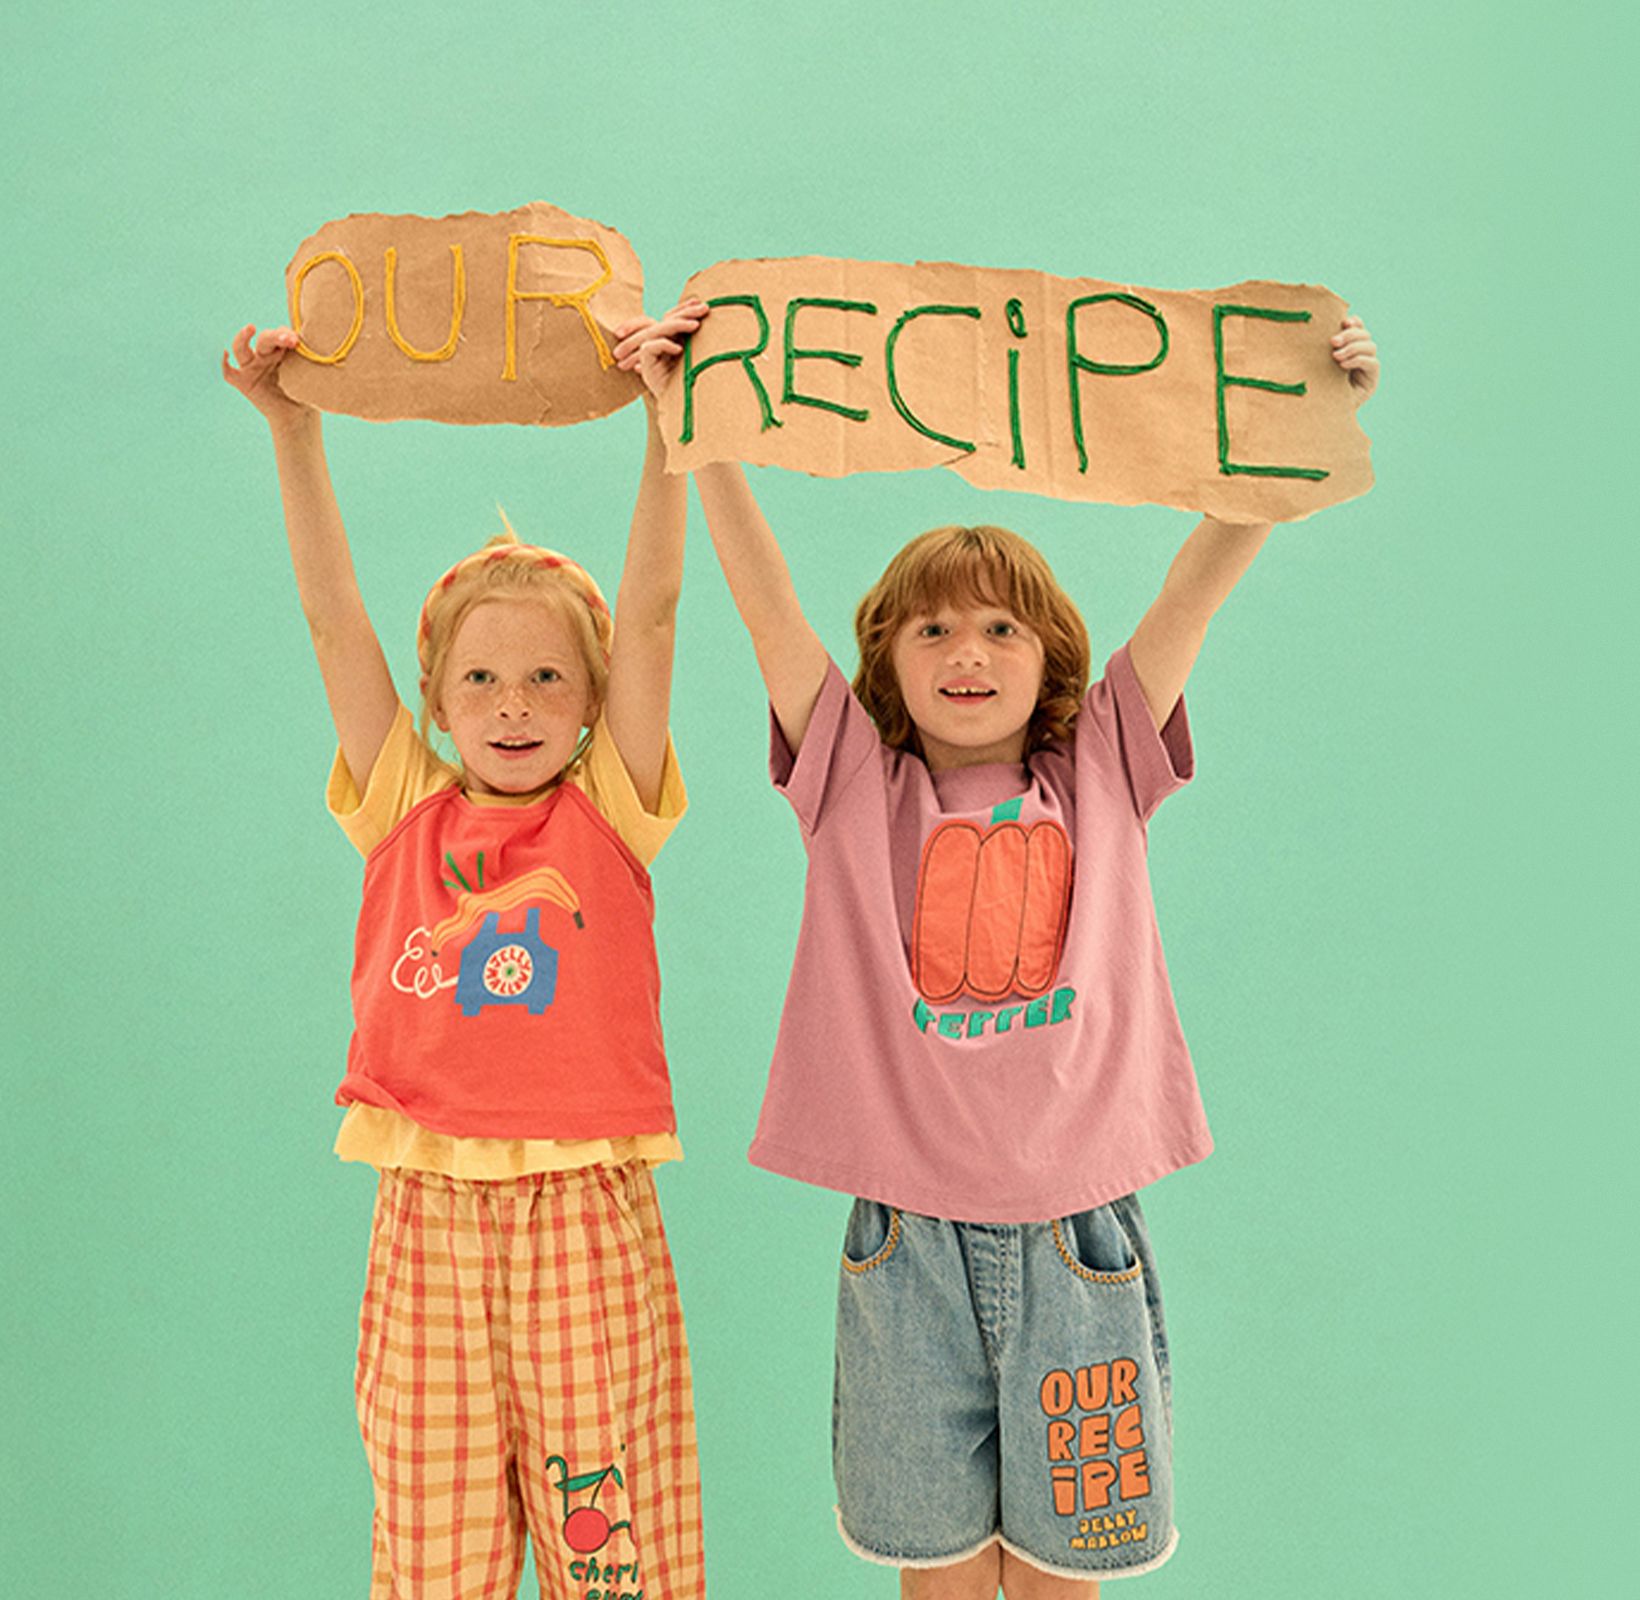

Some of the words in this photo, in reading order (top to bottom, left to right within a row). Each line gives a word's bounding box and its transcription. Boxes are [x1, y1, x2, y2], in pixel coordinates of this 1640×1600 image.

[292, 232, 615, 381] OUR
[1040, 1357, 1139, 1417] OUR
[1047, 1403, 1145, 1461] REC
[1069, 1522, 1147, 1550] MALLOW
[1079, 1508, 1137, 1535] JELLY
